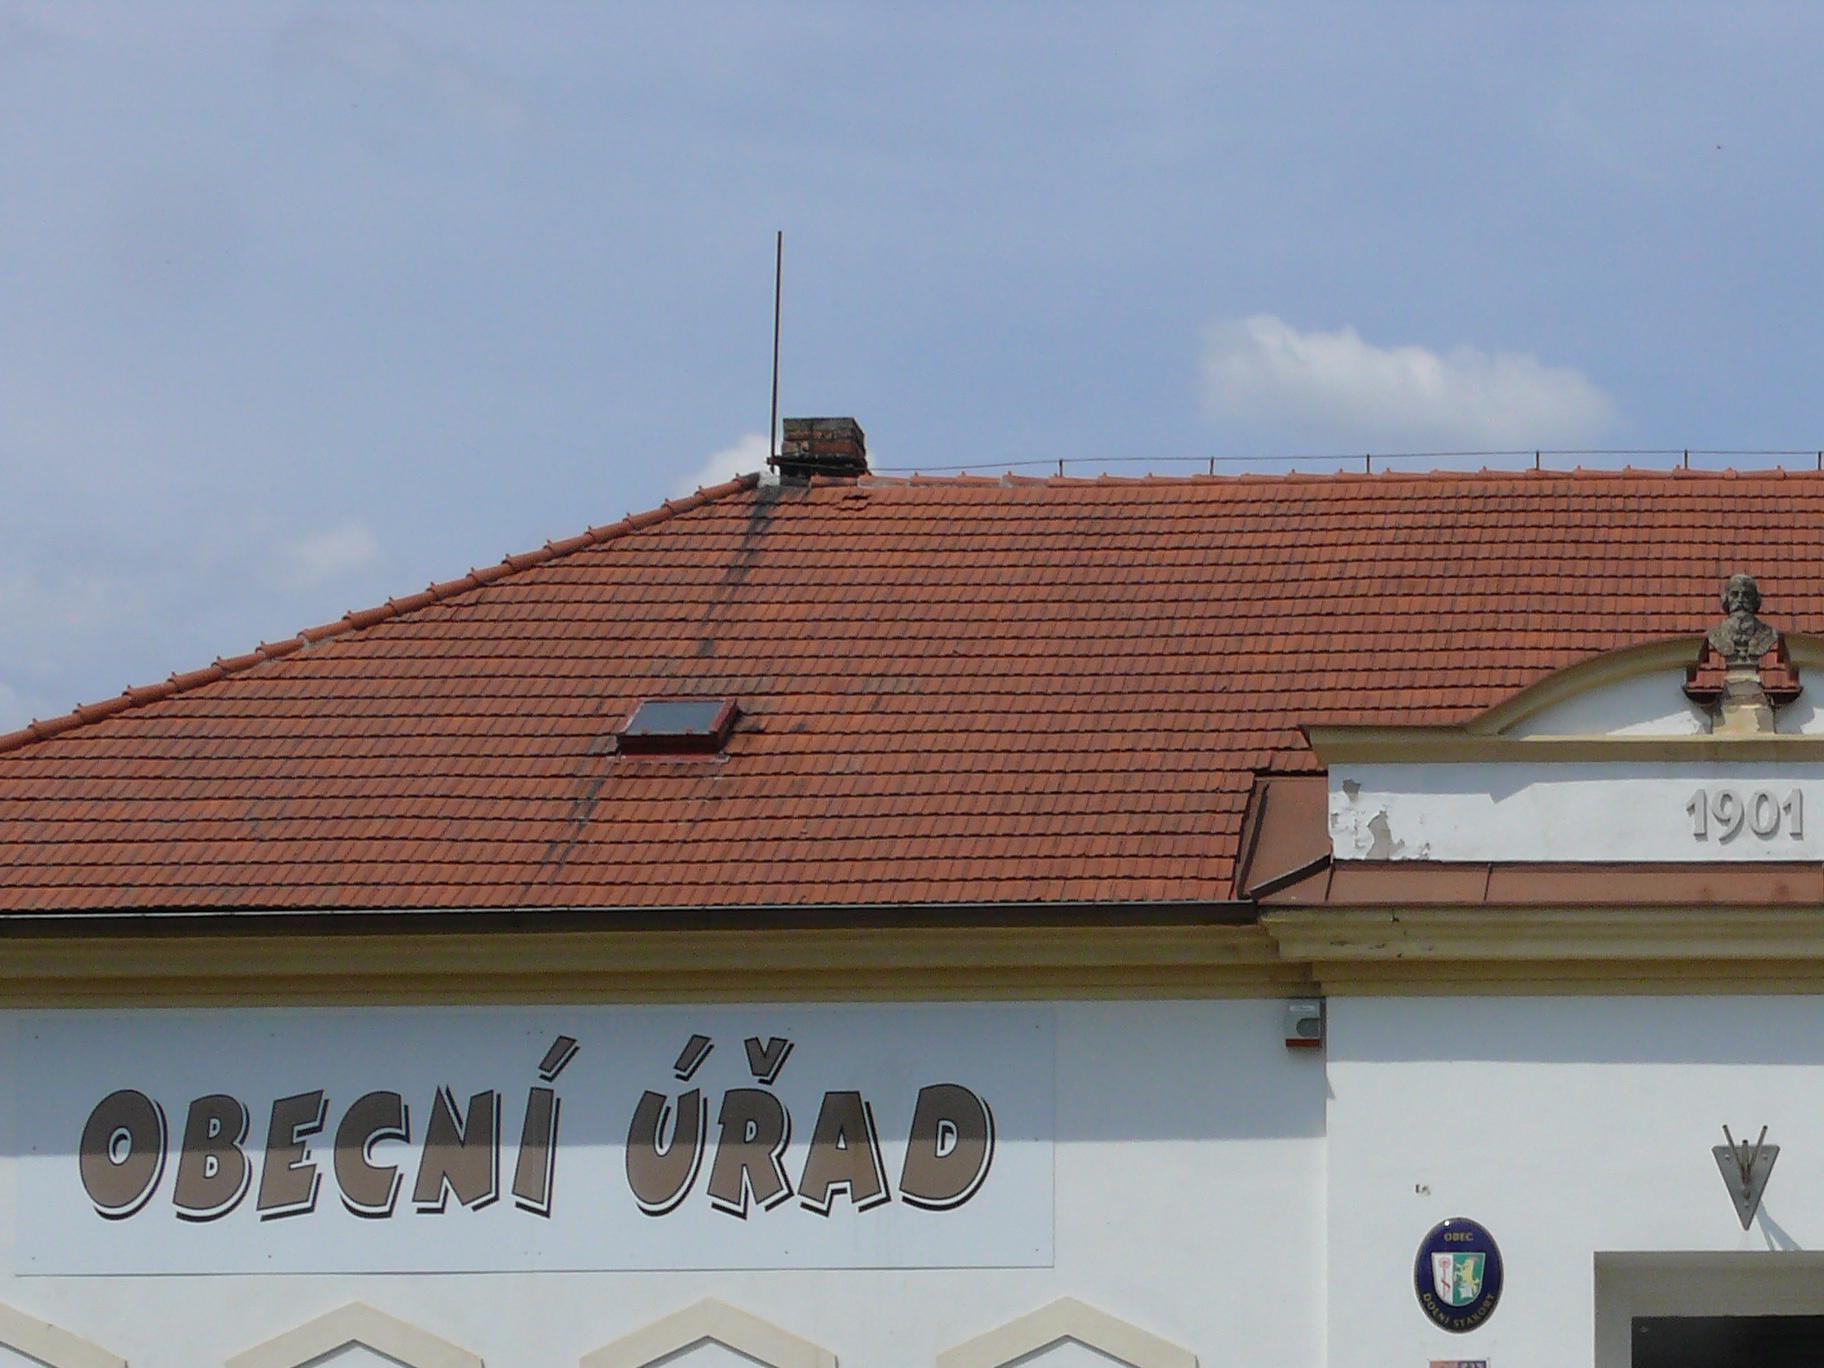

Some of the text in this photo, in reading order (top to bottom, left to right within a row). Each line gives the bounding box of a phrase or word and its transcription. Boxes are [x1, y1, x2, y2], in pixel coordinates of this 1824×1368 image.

[1686, 789, 1804, 845] 1901
[79, 1034, 996, 1222] OBECNÍ ÚŘAD
[1444, 1232, 1474, 1242] OBEC
